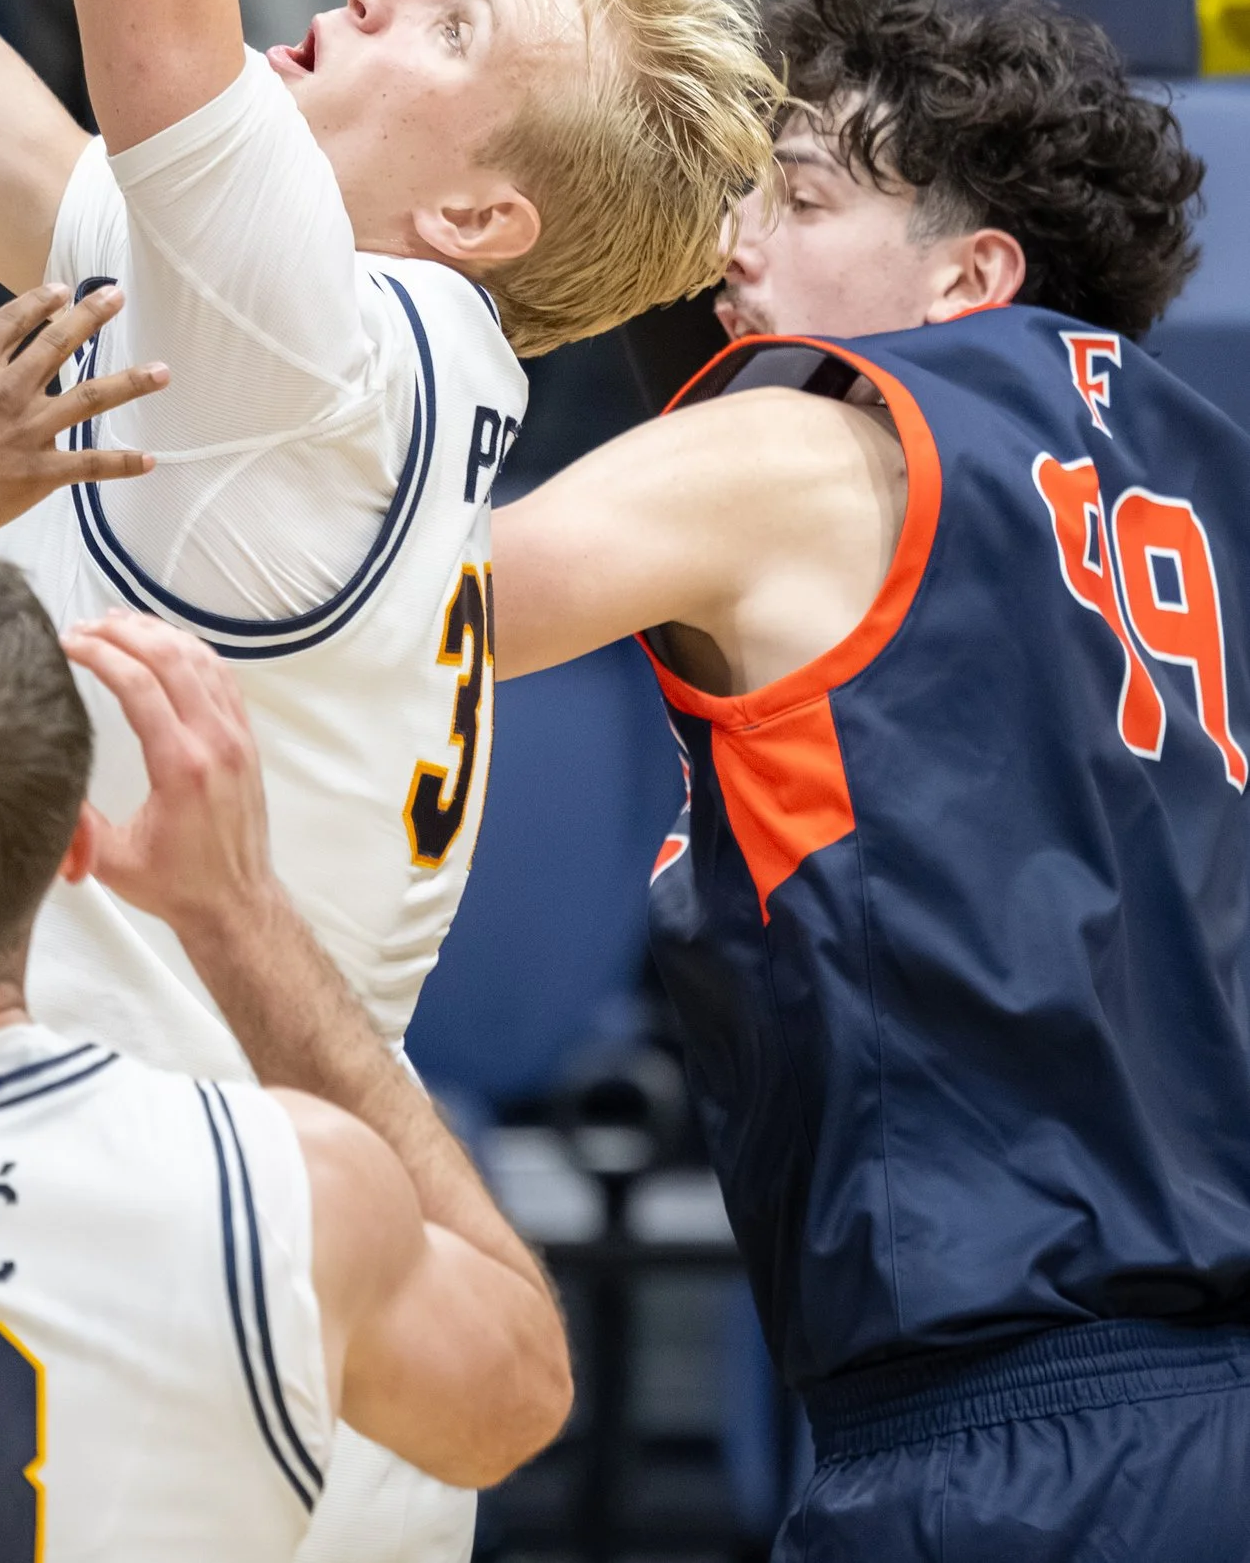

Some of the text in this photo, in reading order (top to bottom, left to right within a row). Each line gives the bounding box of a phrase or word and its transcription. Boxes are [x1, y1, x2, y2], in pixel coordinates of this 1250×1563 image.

[1058, 330, 1122, 439] F
[402, 561, 494, 870] 3
[1031, 451, 1249, 796] 99
